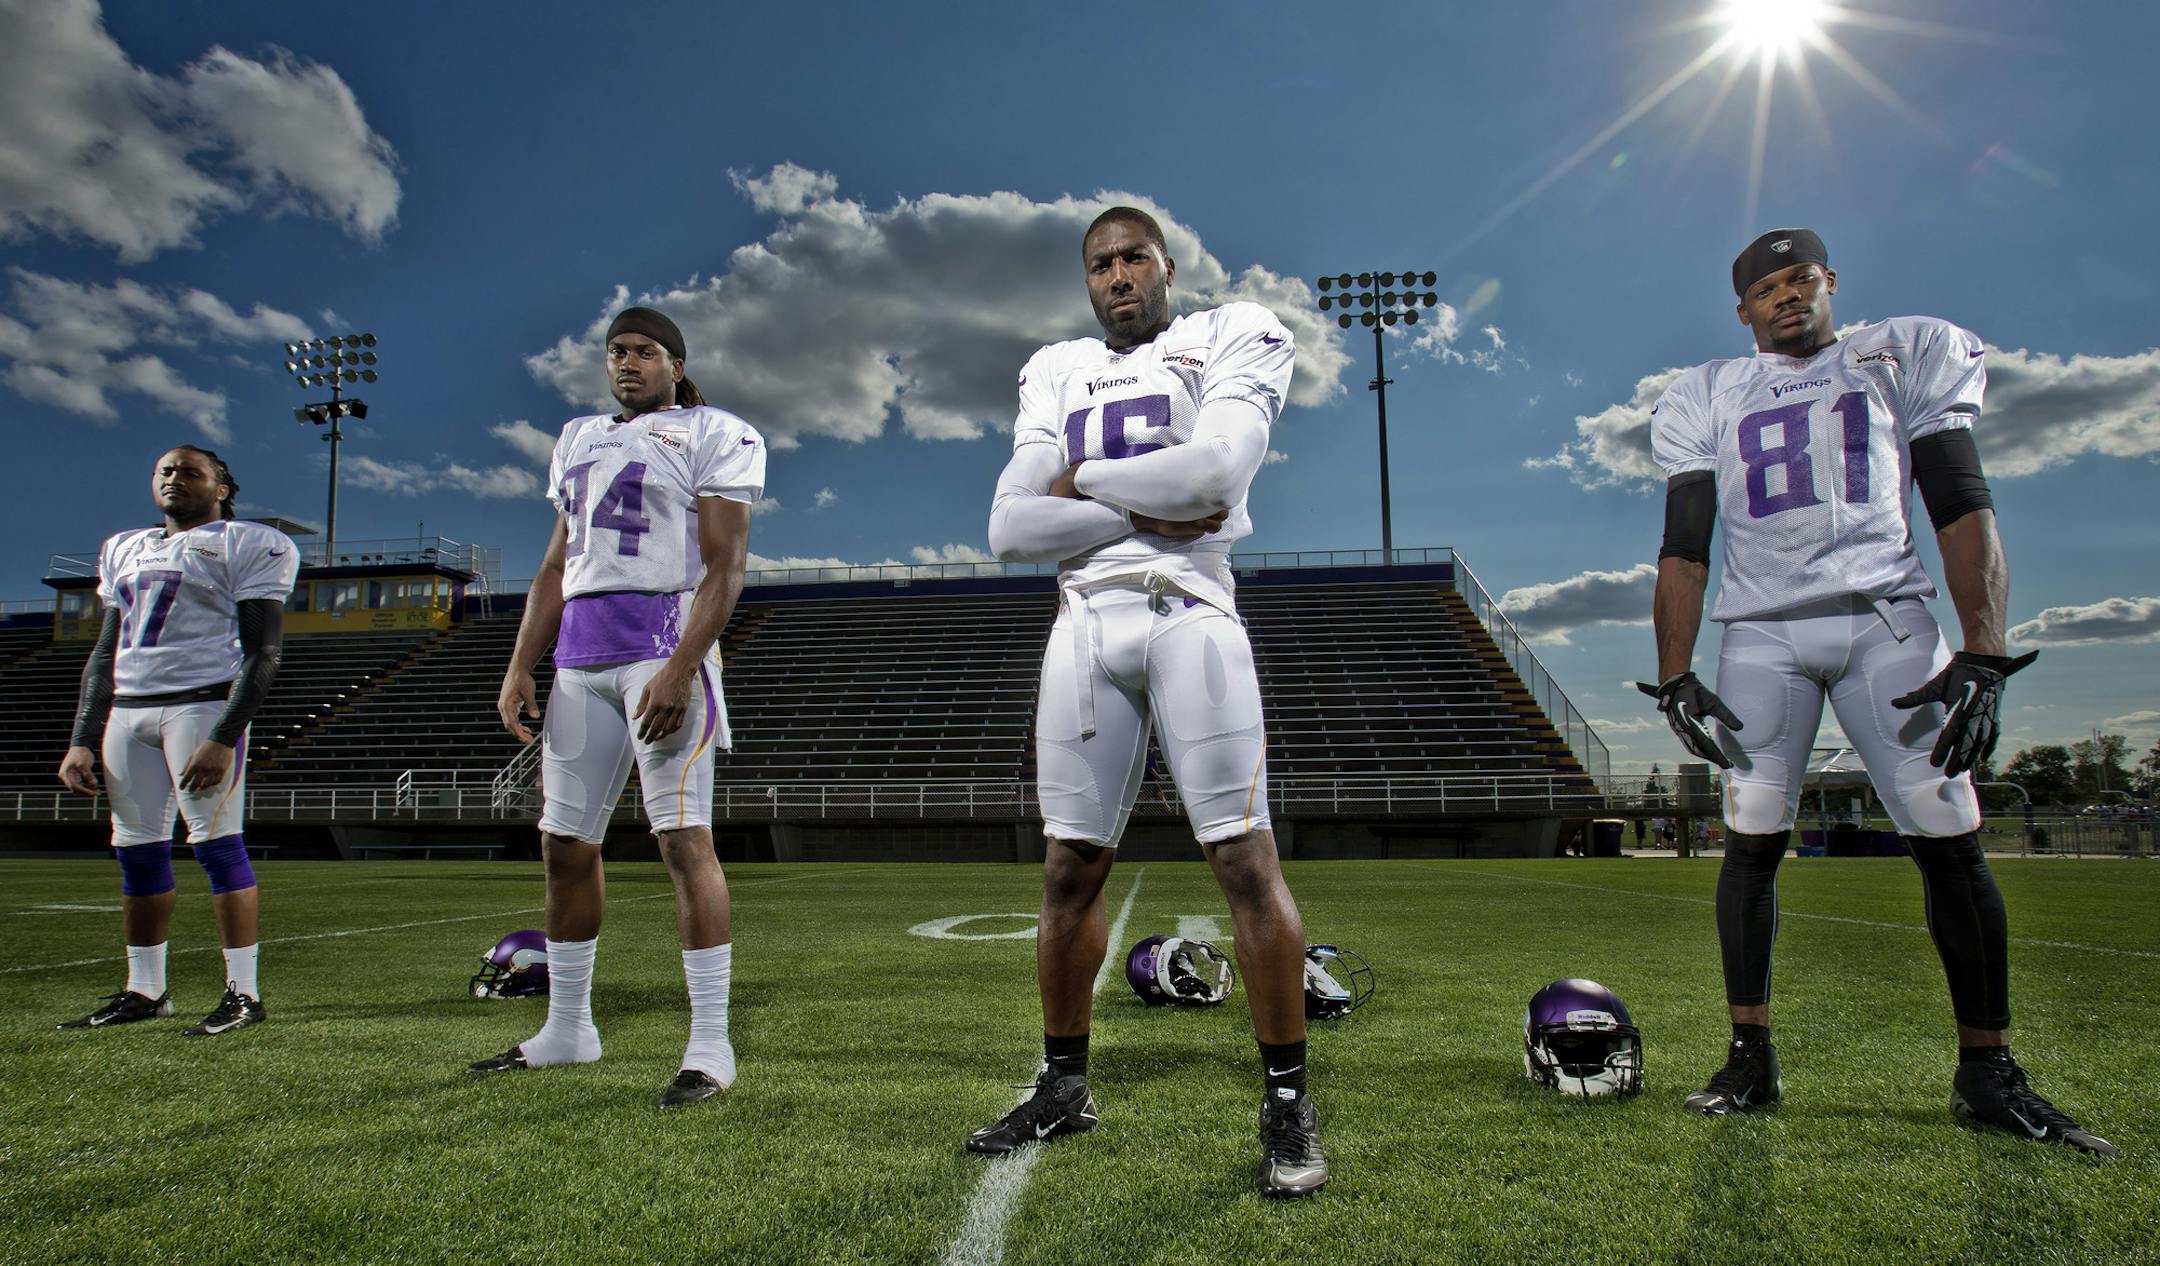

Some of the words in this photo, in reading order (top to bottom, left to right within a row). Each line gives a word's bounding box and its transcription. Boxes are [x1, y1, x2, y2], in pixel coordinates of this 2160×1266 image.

[1162, 353, 1204, 368] verizon
[1857, 351, 1901, 366] verizon
[648, 431, 681, 450] verizon
[1737, 391, 1870, 519] 81
[117, 570, 182, 649] 17
